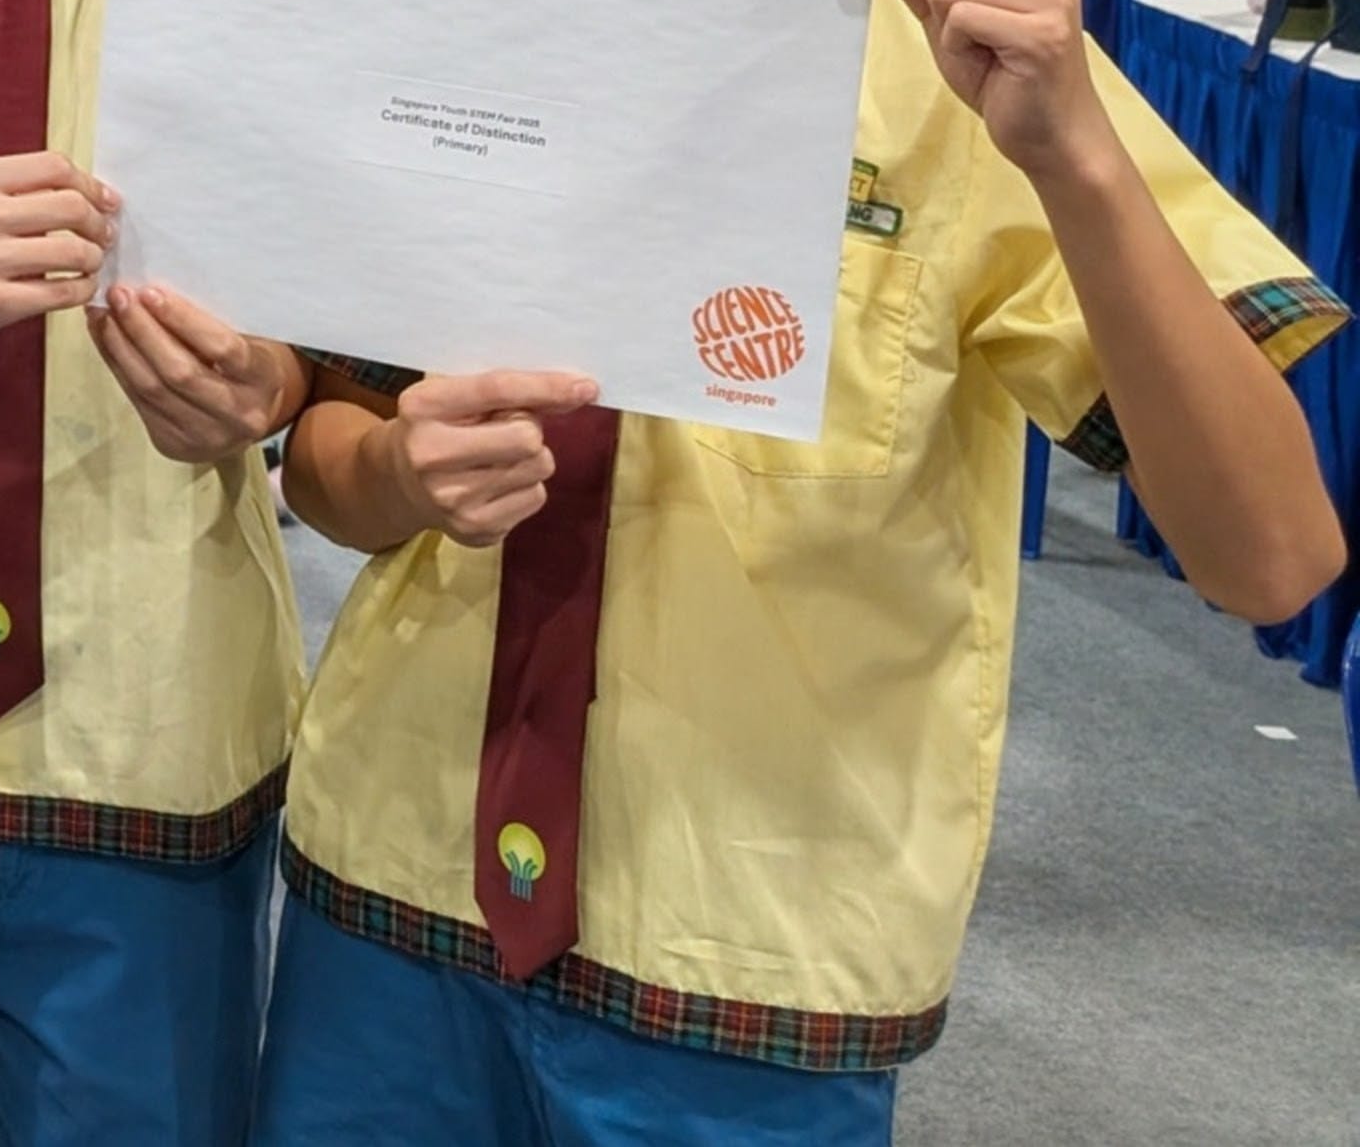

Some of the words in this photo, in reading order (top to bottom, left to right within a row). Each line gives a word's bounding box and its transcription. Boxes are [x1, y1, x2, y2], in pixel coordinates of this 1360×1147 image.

[381, 109, 452, 132] Certificate
[455, 121, 469, 133] of
[471, 123, 546, 147] Distinction
[391, 96, 438, 113] Singapore
[440, 104, 468, 116] Youth
[469, 109, 496, 121] STEM
[497, 114, 516, 124] Fair
[517, 117, 540, 128] 2025
[433, 135, 488, 157] (Primary)
[692, 286, 800, 344] SCIENCE
[698, 324, 805, 381] CENTRE
[706, 384, 777, 407] singapore
